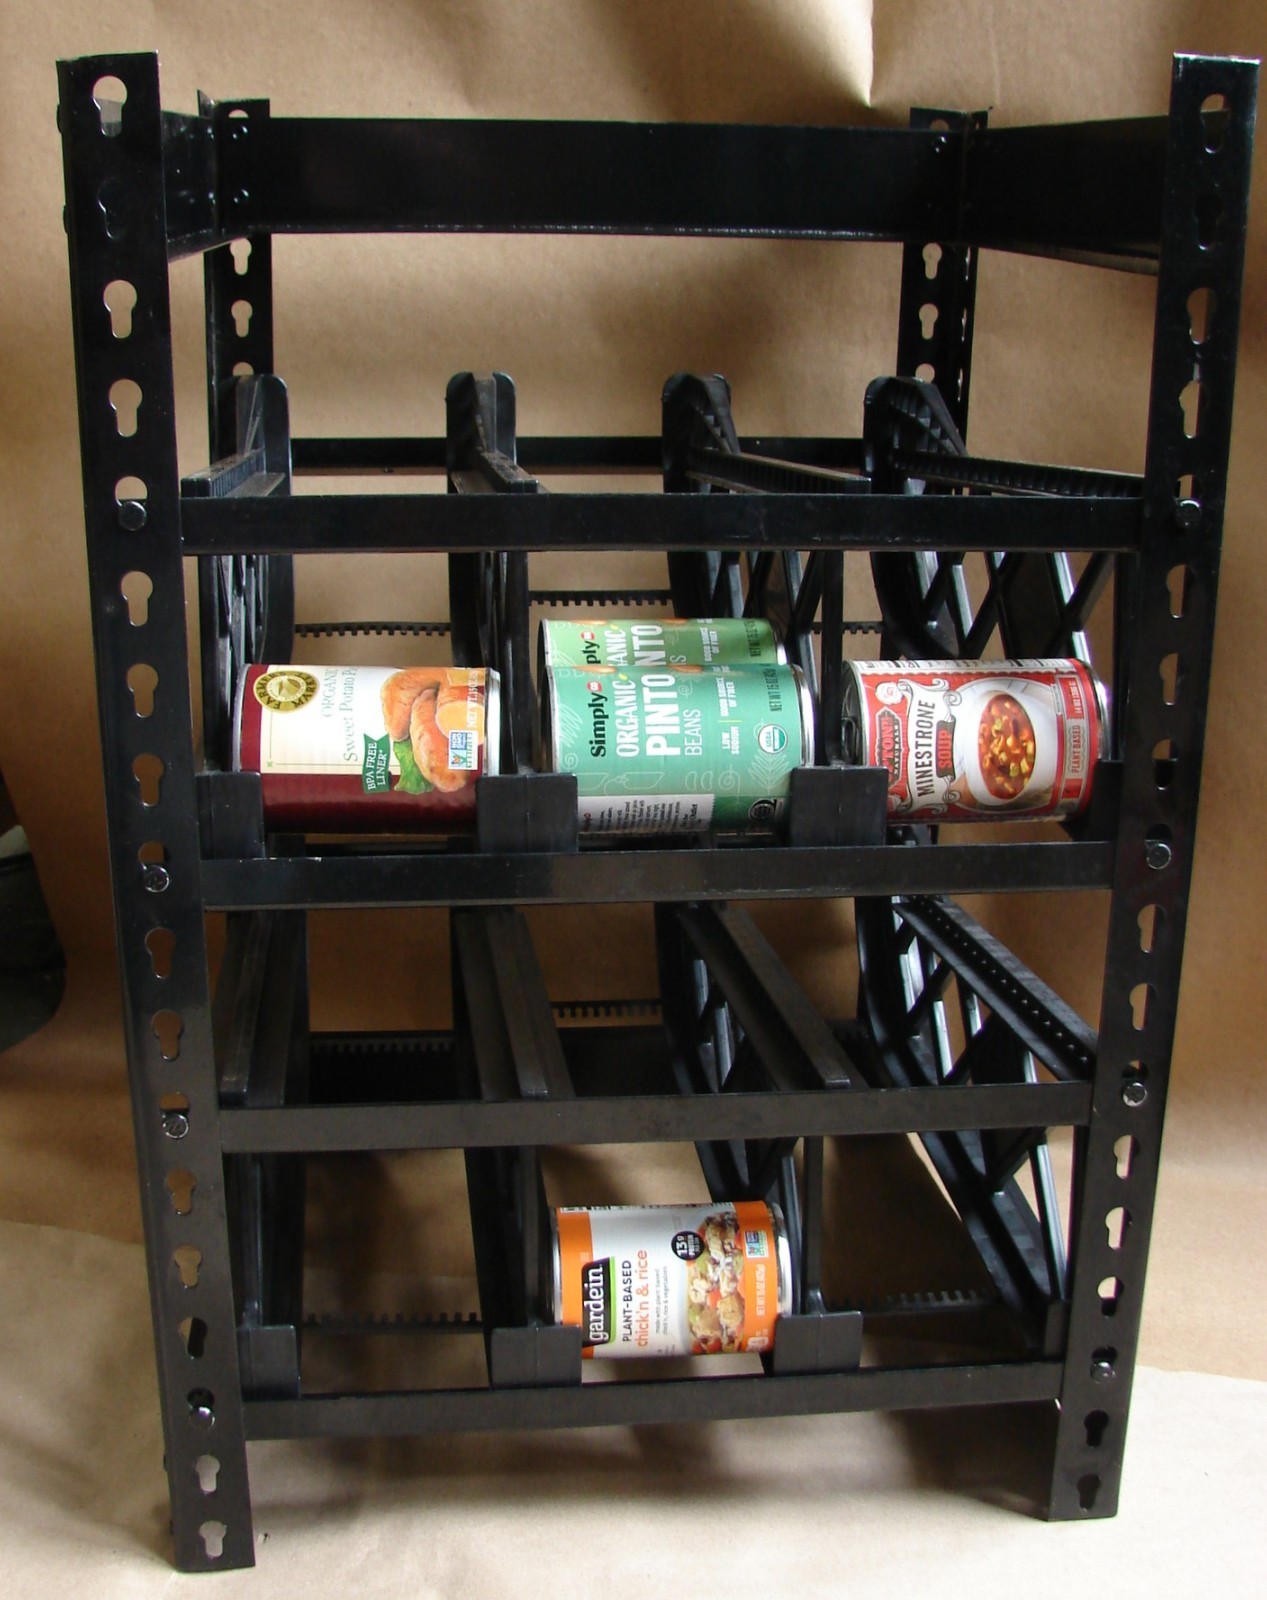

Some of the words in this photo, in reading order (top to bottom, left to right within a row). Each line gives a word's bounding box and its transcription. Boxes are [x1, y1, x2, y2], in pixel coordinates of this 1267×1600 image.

[631, 625, 667, 666] NTO
[338, 677, 355, 711] Potato
[590, 692, 608, 757] Simply
[614, 680, 640, 757] ORGANIC
[642, 674, 681, 756] PINTO
[683, 709, 703, 756] BEANS
[342, 717, 358, 762] Sweet
[365, 742, 377, 769] FREE
[730, 726, 740, 755] SODIUM
[917, 699, 936, 797] MINESTRONE
[938, 729, 953, 769] SOUP
[1071, 724, 1081, 749] BASED
[365, 771, 377, 790] BPA
[1071, 750, 1081, 774] PLANT
[634, 1250, 649, 1280] rice
[583, 1266, 609, 1342] gardein
[621, 1260, 633, 1343] PLANT-BASED
[635, 1283, 649, 1297] &
[634, 1301, 649, 1347] chick'n
